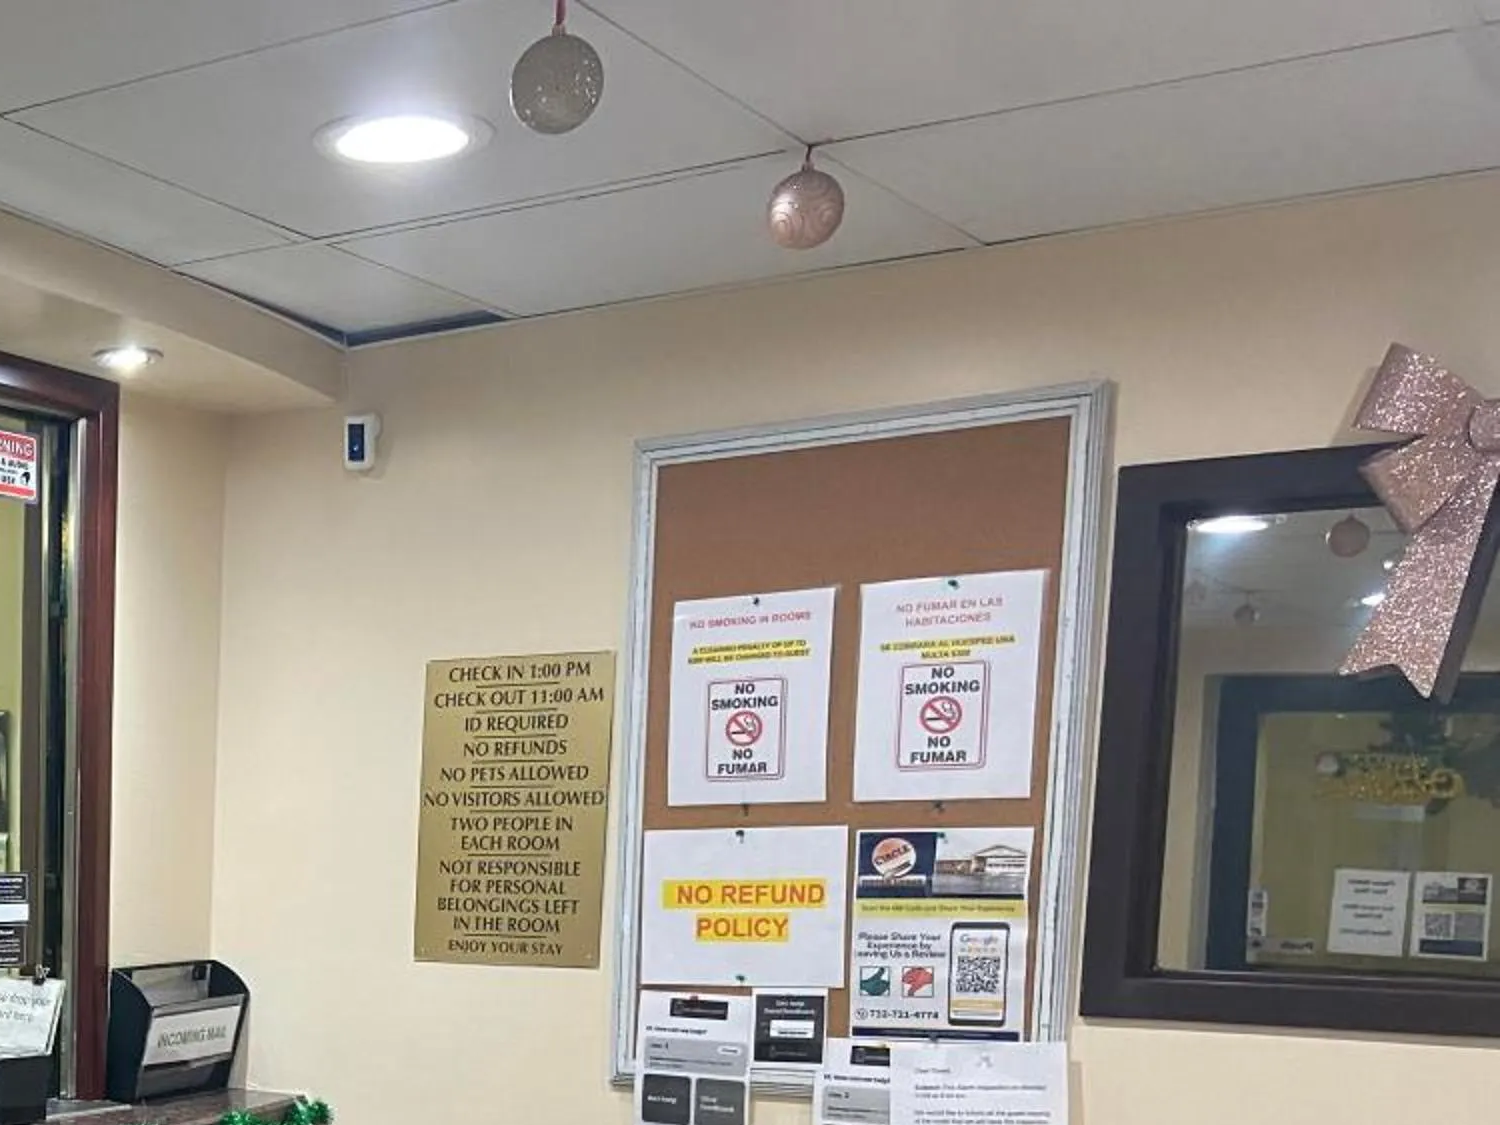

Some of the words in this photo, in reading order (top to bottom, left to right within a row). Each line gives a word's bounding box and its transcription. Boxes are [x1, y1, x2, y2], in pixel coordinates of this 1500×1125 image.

[896, 604, 913, 613] NO
[916, 600, 957, 613] FUMAR
[961, 599, 976, 608] EN
[980, 597, 1003, 607] LAS
[689, 620, 705, 629] NO
[708, 615, 756, 628] SMOKING
[760, 615, 769, 623] IN
[772, 610, 811, 623] ROOMS
[905, 612, 992, 627] HABITACIONES
[450, 665, 501, 682] CHECK
[507, 663, 524, 679] IN
[531, 663, 561, 679] 1:00
[566, 661, 591, 677] PM
[931, 667, 954, 679] NO
[734, 683, 755, 695] NO
[905, 680, 980, 695] SMOKING
[435, 690, 486, 709] CHECK
[490, 689, 526, 706] OUT
[532, 688, 573, 705] 11:00
[577, 686, 604, 702] AM
[712, 695, 778, 710] SMOKING
[465, 716, 480, 732] ID
[487, 714, 569, 733] REQUIRED
[464, 742, 488, 757] NO
[494, 740, 567, 756] REFUNDS
[927, 736, 950, 749] NO
[733, 748, 753, 760] NO
[911, 750, 966, 763] FUMAR
[440, 767, 466, 782] NO
[470, 766, 505, 782] PETS
[509, 765, 589, 781] ALLOWED
[718, 761, 767, 775] FUMAR
[424, 792, 449, 807] NO
[451, 791, 520, 807] VISITORS
[524, 791, 605, 807] ALLOWED
[450, 817, 488, 831] TWO
[493, 816, 551, 832] PEOPLE
[556, 817, 573, 830] IN
[461, 836, 501, 850] EACH
[507, 836, 560, 851] ROOM
[875, 845, 911, 866] CIRCLE
[439, 860, 473, 875] NOT
[478, 860, 581, 876] RESPONSIBLE
[450, 879, 480, 893] FOR
[486, 880, 565, 895] PERSONAL
[677, 885, 715, 905] NO
[722, 884, 826, 905] REFUND
[437, 897, 539, 914] BELONGINGS
[545, 899, 579, 915] LEFT
[454, 916, 470, 930] IN
[474, 917, 502, 931] THE
[507, 918, 560, 933] ROOM
[696, 918, 788, 938] POLICY
[448, 940, 486, 952] ENJOY
[491, 941, 527, 954] YOUR
[531, 943, 563, 956] STAY
